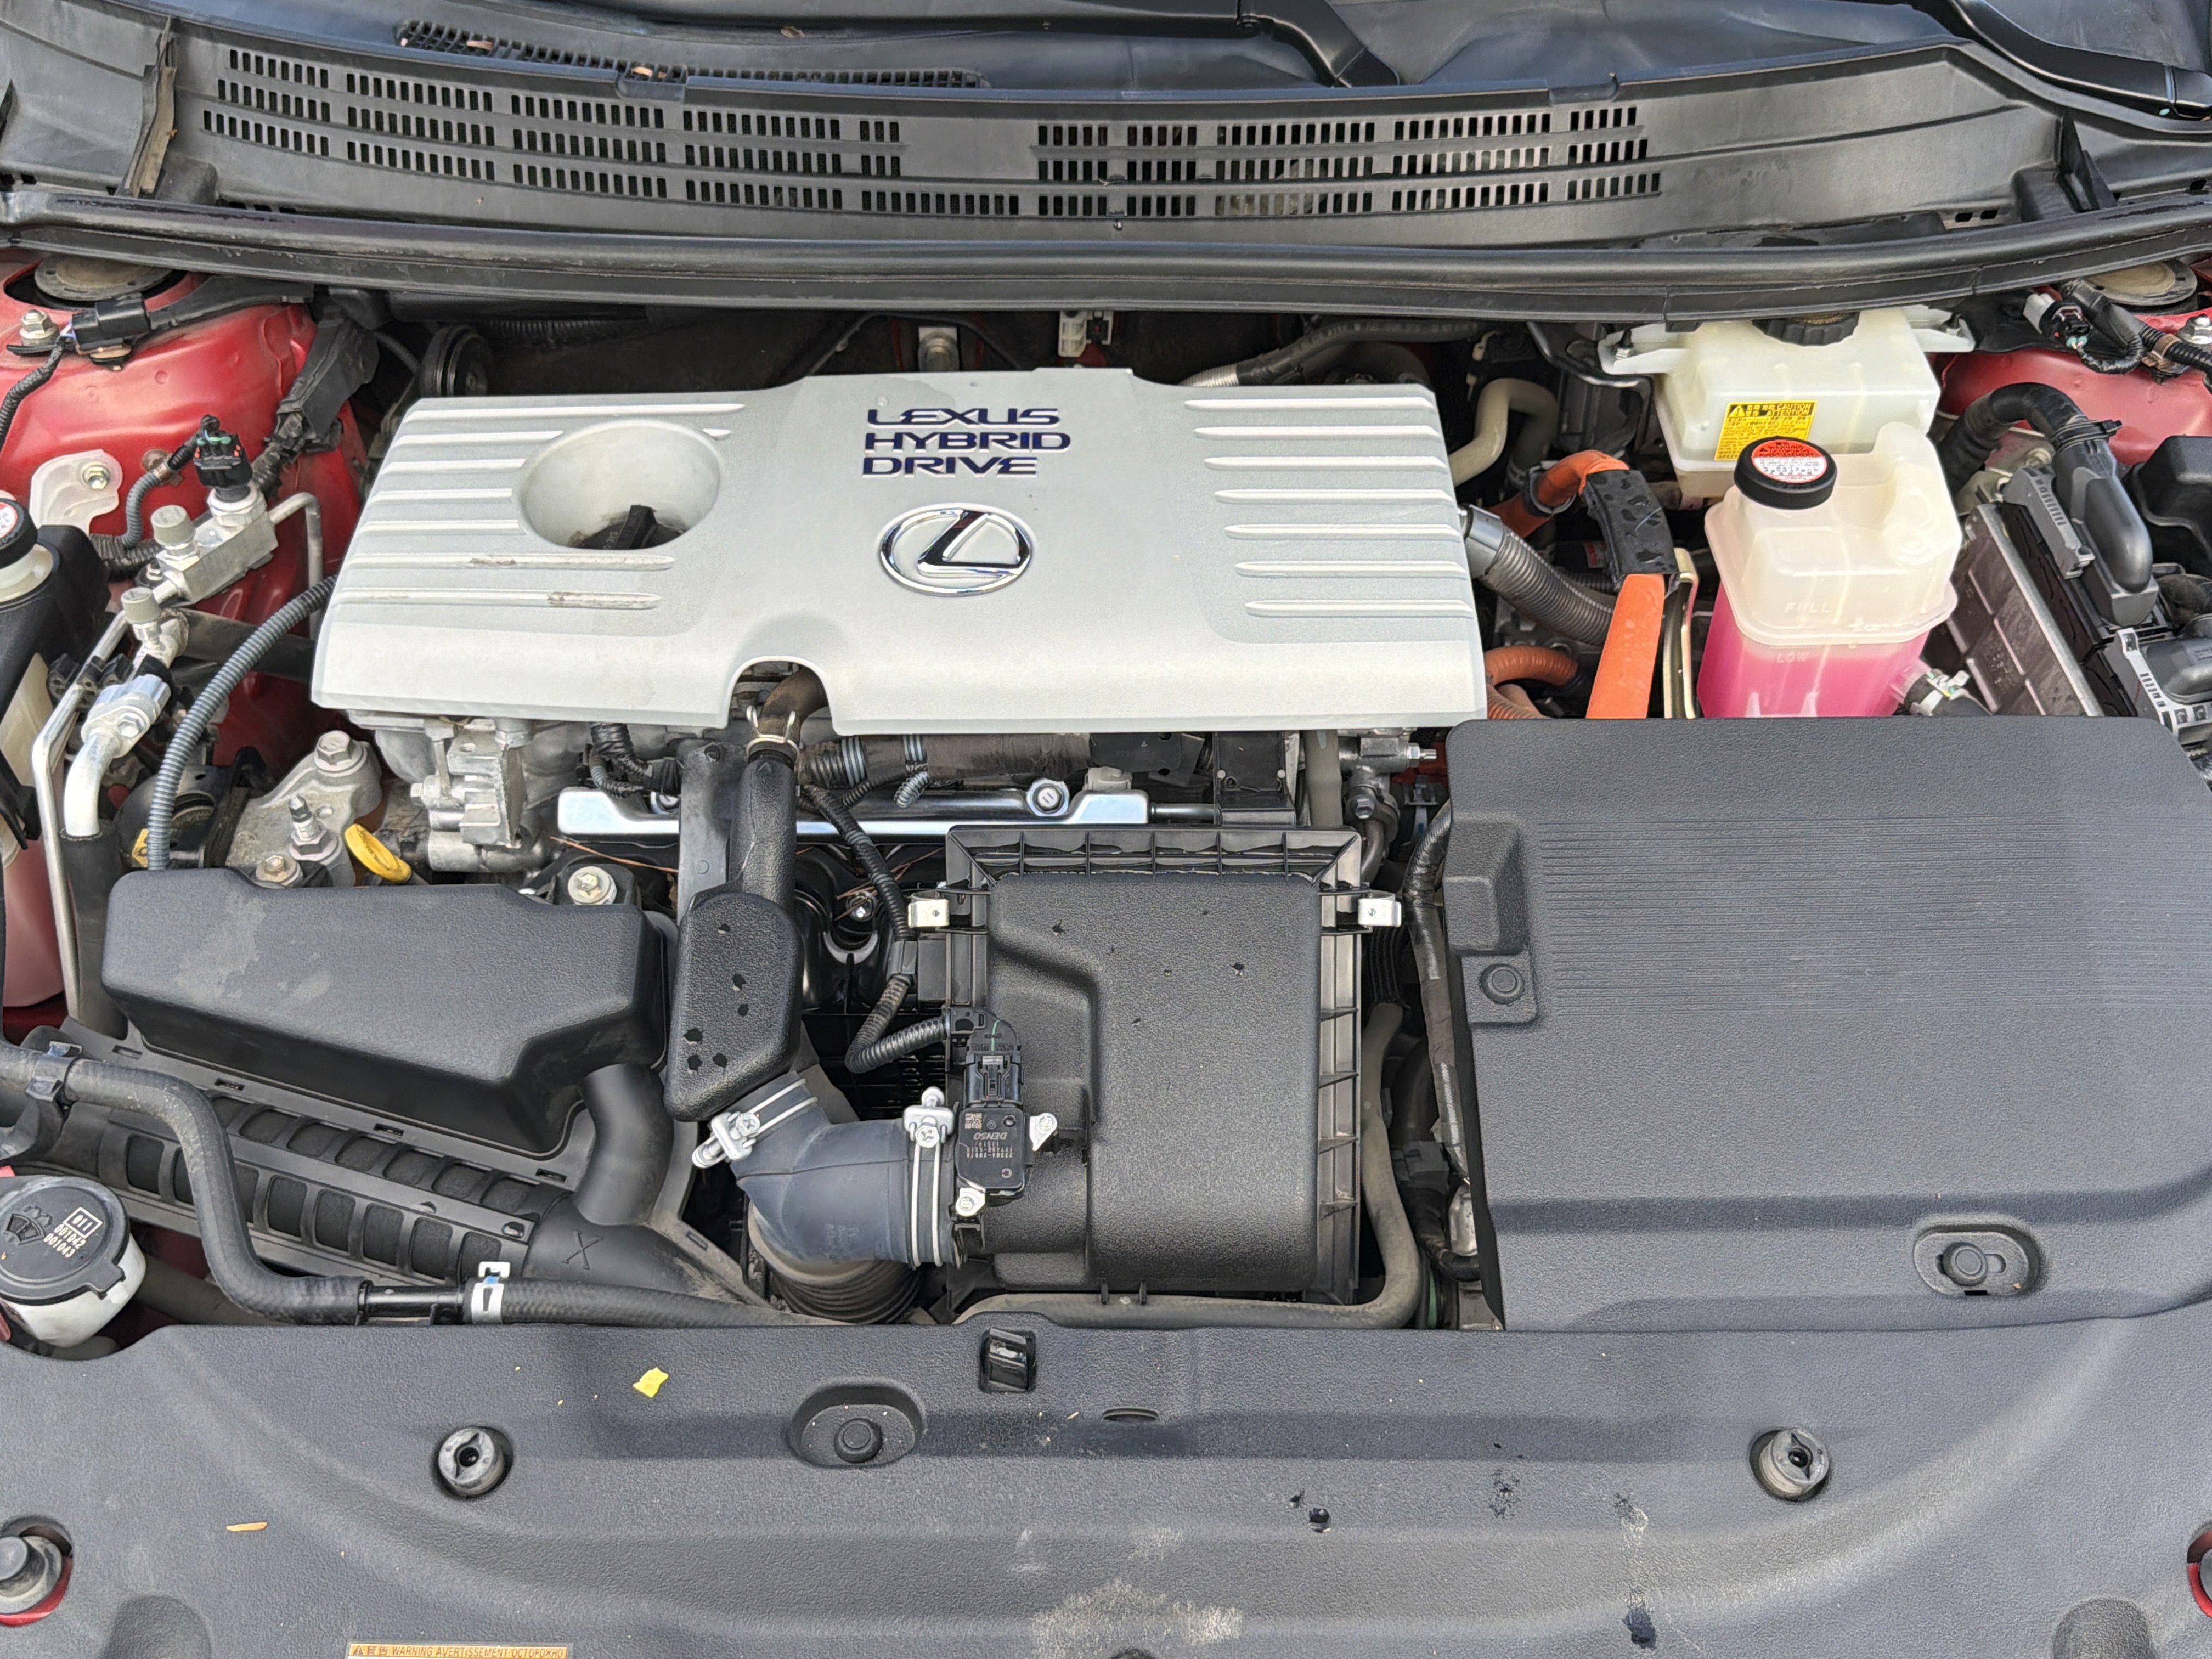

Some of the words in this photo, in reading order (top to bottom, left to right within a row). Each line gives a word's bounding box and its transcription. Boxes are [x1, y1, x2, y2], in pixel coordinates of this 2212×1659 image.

[867, 408, 1060, 427] LEXUS
[865, 432, 1071, 452] HYBRID
[862, 456, 1038, 477] DRIVE
[1776, 651, 1809, 663] LOW
[973, 1132, 1008, 1140] DENSO
[44, 1233, 76, 1257] 001043
[54, 1224, 86, 1249] 001042
[392, 1646, 433, 1656] WARNING
[436, 1647, 507, 1658] AVERTISSEMENT
